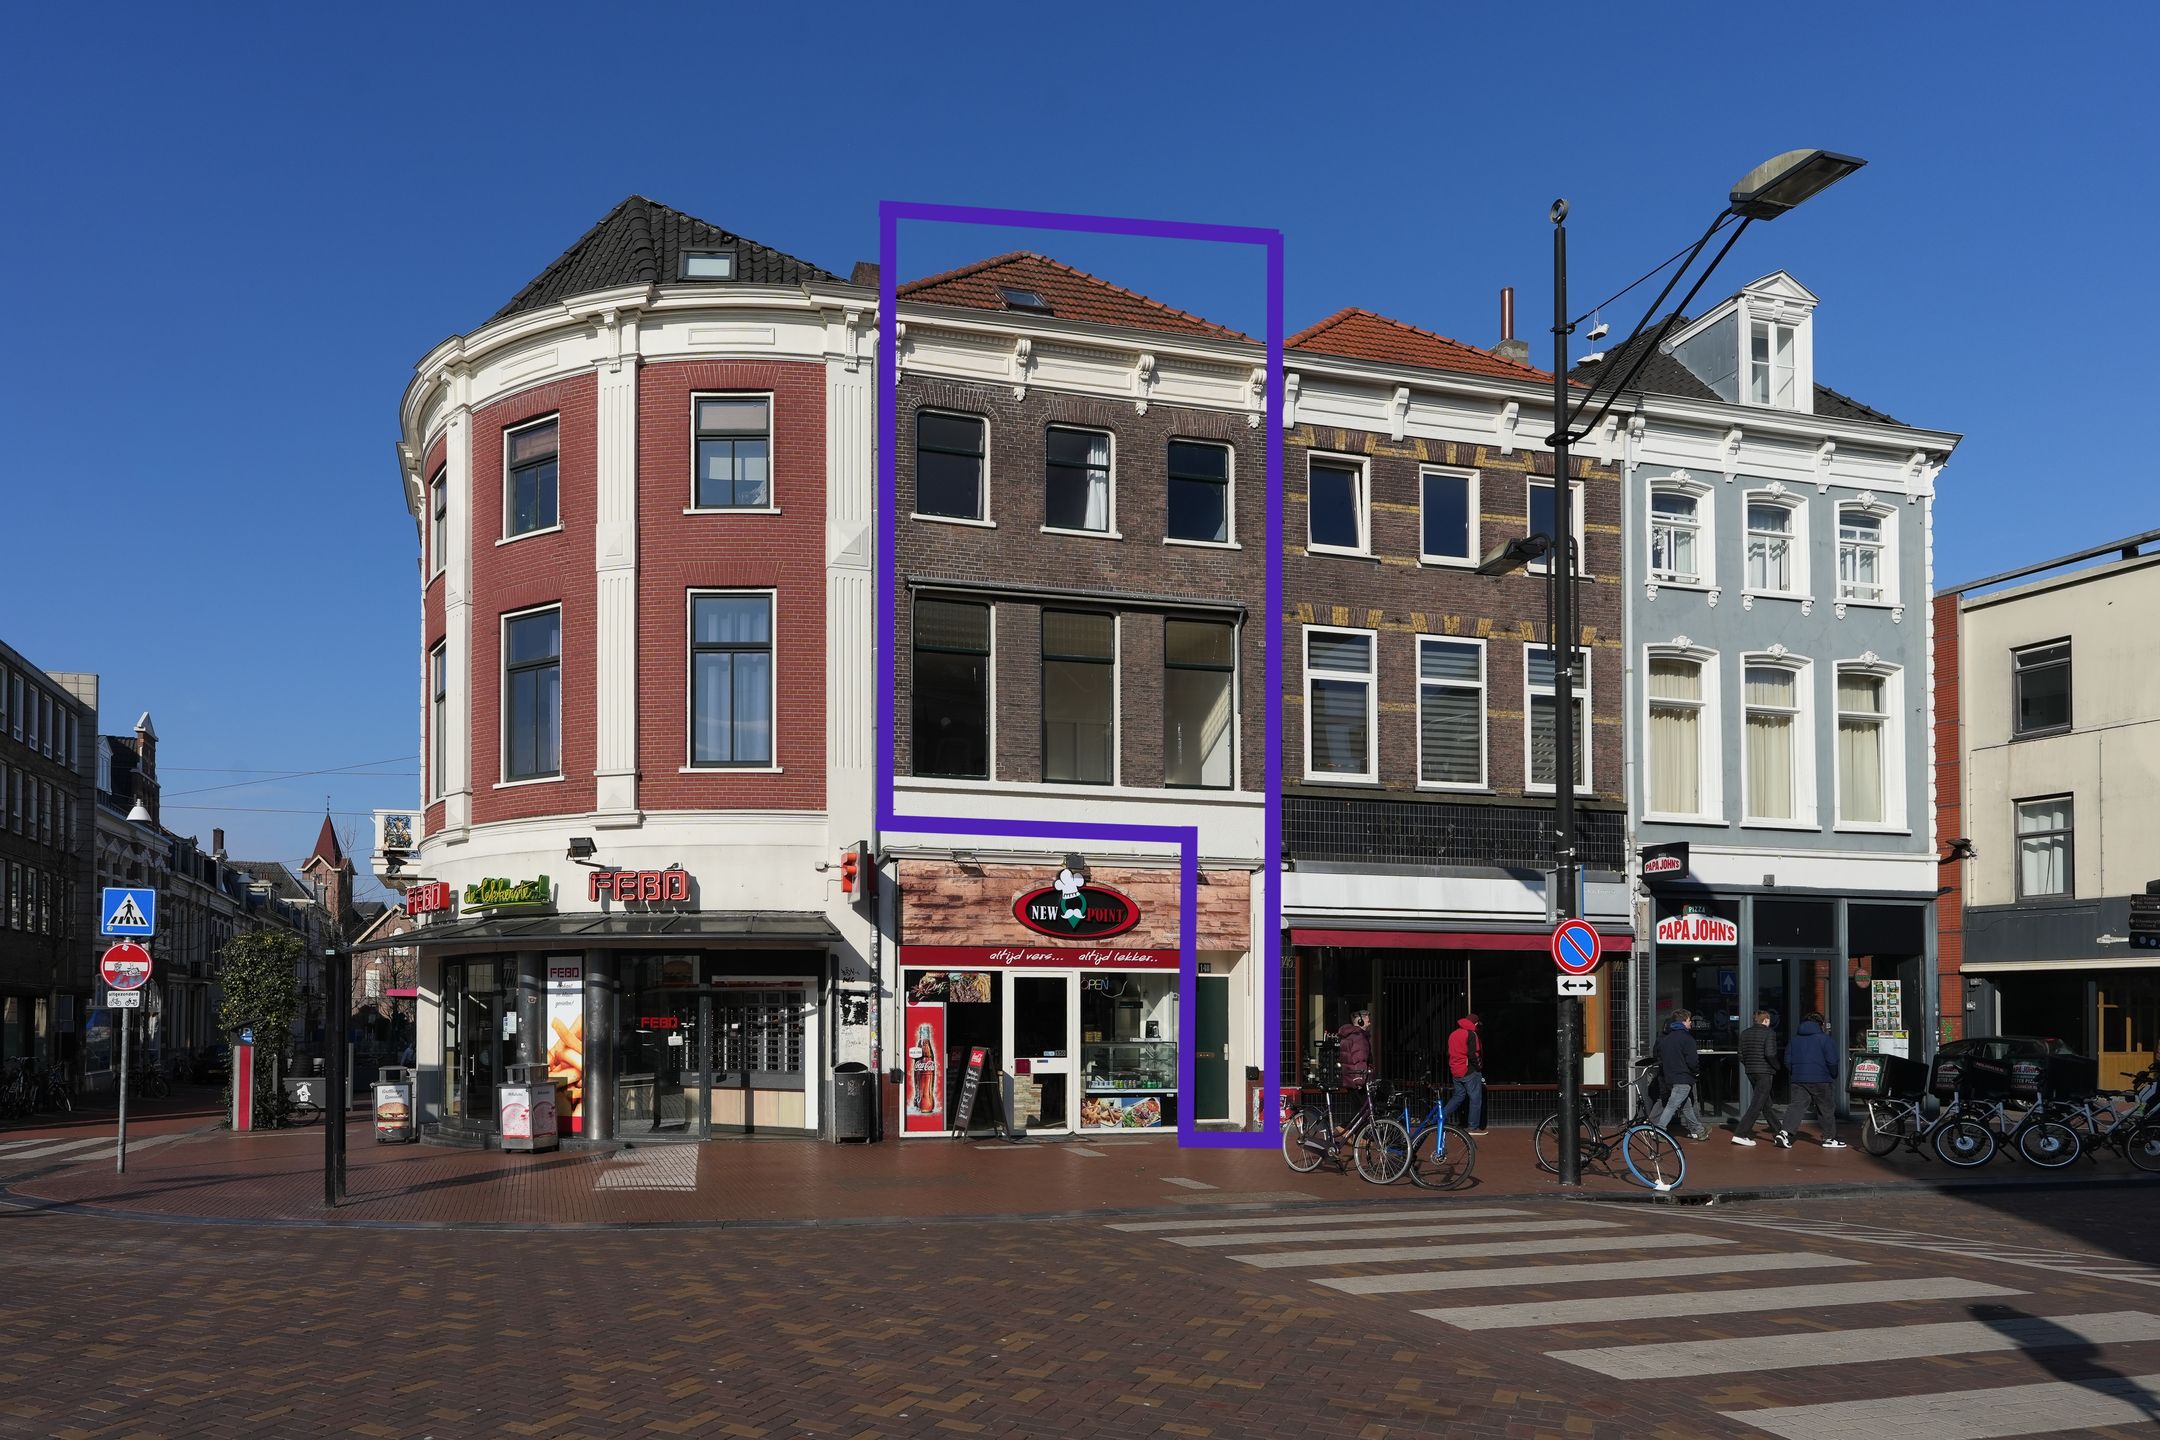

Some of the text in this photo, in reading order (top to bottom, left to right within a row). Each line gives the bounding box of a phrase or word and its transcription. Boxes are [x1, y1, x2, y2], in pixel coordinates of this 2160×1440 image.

[1645, 861, 1659, 872] PAPA
[588, 870, 687, 902] FEBO
[405, 882, 442, 915] FEBO
[1031, 905, 1124, 923] NEW POINT
[1688, 905, 1706, 913] PIZZA
[1659, 919, 1735, 942] PAPA JOHN'S
[989, 949, 1065, 965] altijd vers...
[1078, 950, 1112, 966] altijd
[550, 967, 580, 978] FEBO
[1080, 979, 1109, 990] OPEN
[108, 991, 139, 999] uitgezonderd
[641, 1017, 678, 1029] FEBO
